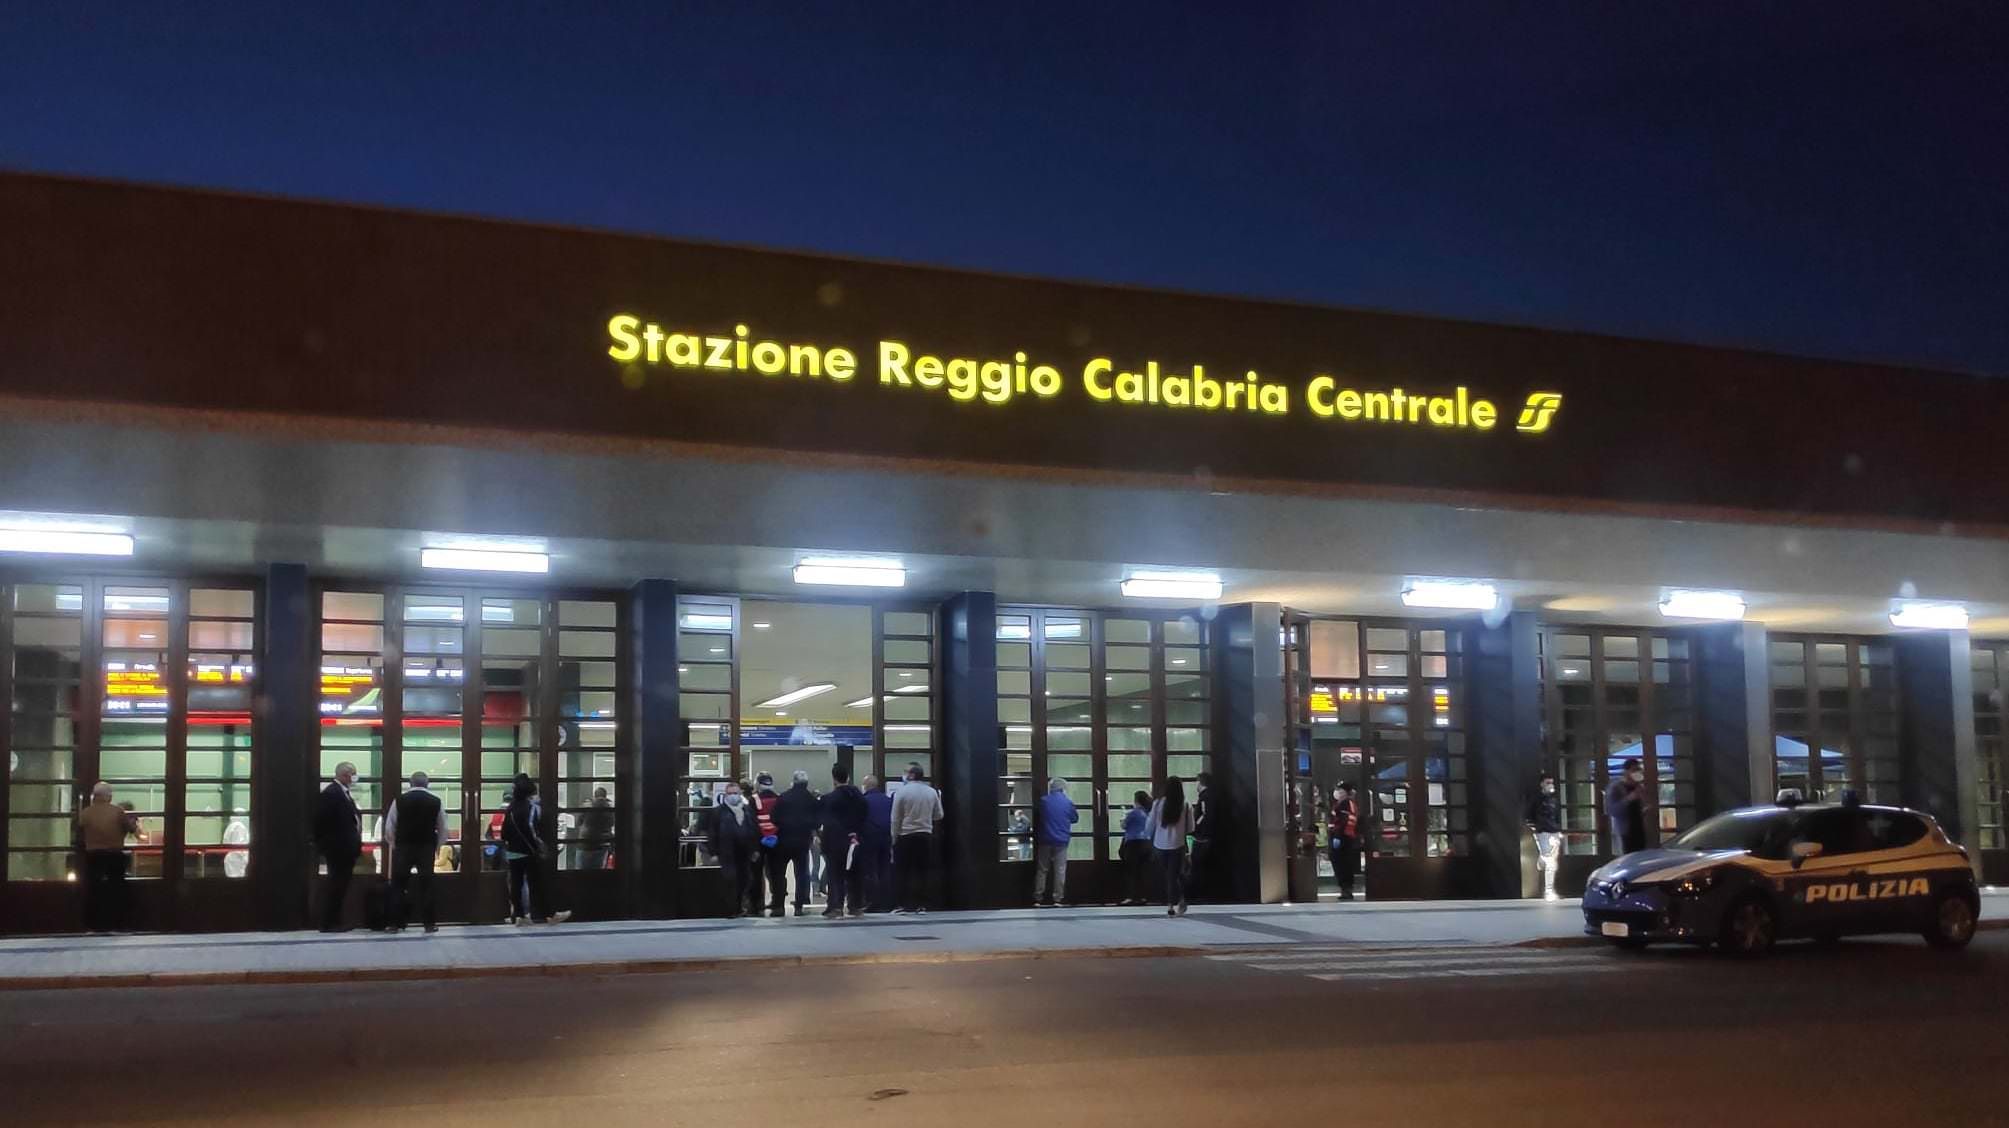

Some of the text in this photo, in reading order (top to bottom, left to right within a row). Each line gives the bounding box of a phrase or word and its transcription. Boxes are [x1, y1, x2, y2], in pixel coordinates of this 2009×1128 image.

[608, 314, 857, 381] Stazione
[879, 340, 1062, 404] Reggio
[1083, 357, 1289, 414] Calabria
[1306, 376, 1497, 429] Centrale
[1805, 877, 1930, 904] POLIZIA
